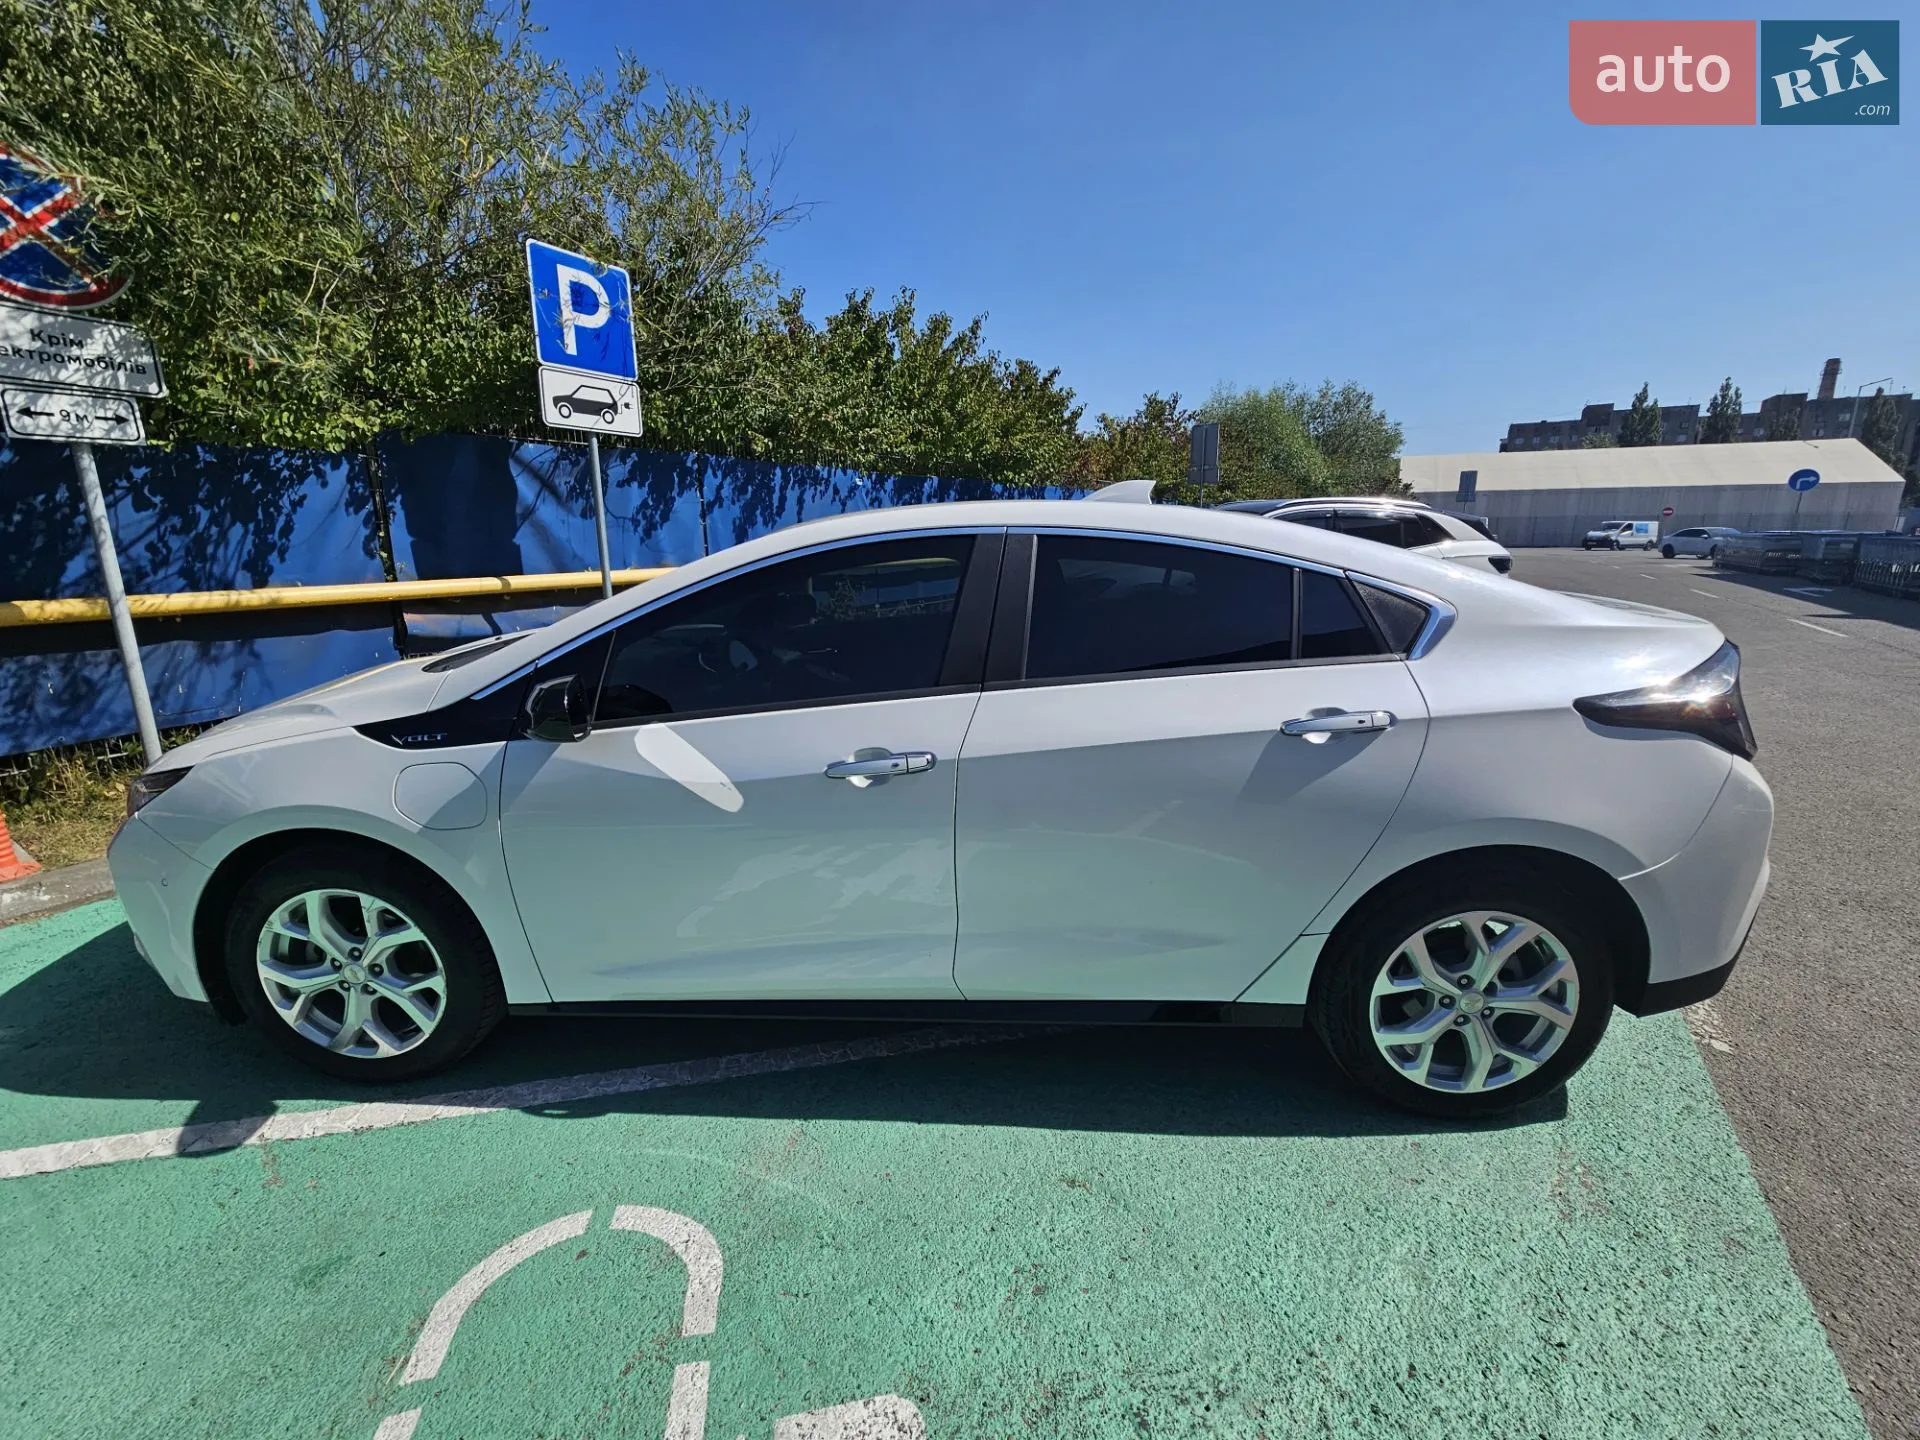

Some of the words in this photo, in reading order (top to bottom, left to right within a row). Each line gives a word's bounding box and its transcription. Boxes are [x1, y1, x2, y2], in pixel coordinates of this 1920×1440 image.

[556, 263, 611, 356] P
[30, 328, 84, 349] Крім
[60, 409, 71, 422] 9
[390, 732, 448, 745] VOLT
